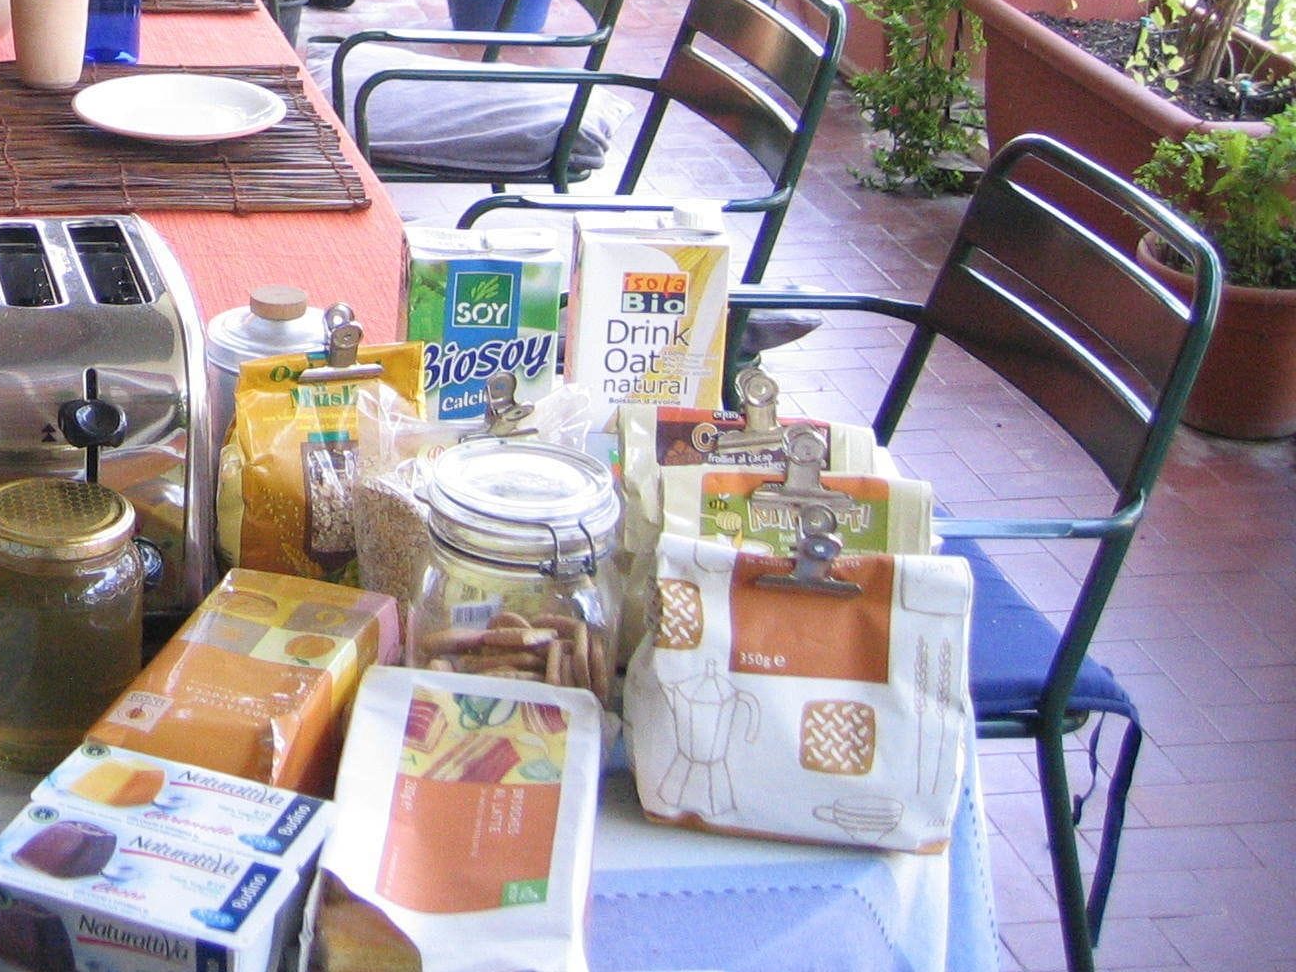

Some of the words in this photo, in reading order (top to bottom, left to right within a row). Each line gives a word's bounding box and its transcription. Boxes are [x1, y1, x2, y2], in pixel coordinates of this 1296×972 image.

[624, 273, 686, 296] isola
[456, 301, 508, 325] SOY
[623, 293, 685, 313] Bio
[607, 319, 689, 346] Drink
[605, 348, 660, 373] Oat
[603, 376, 688, 395] natural
[739, 651, 771, 669] 350g
[230, 872, 267, 909] Budino
